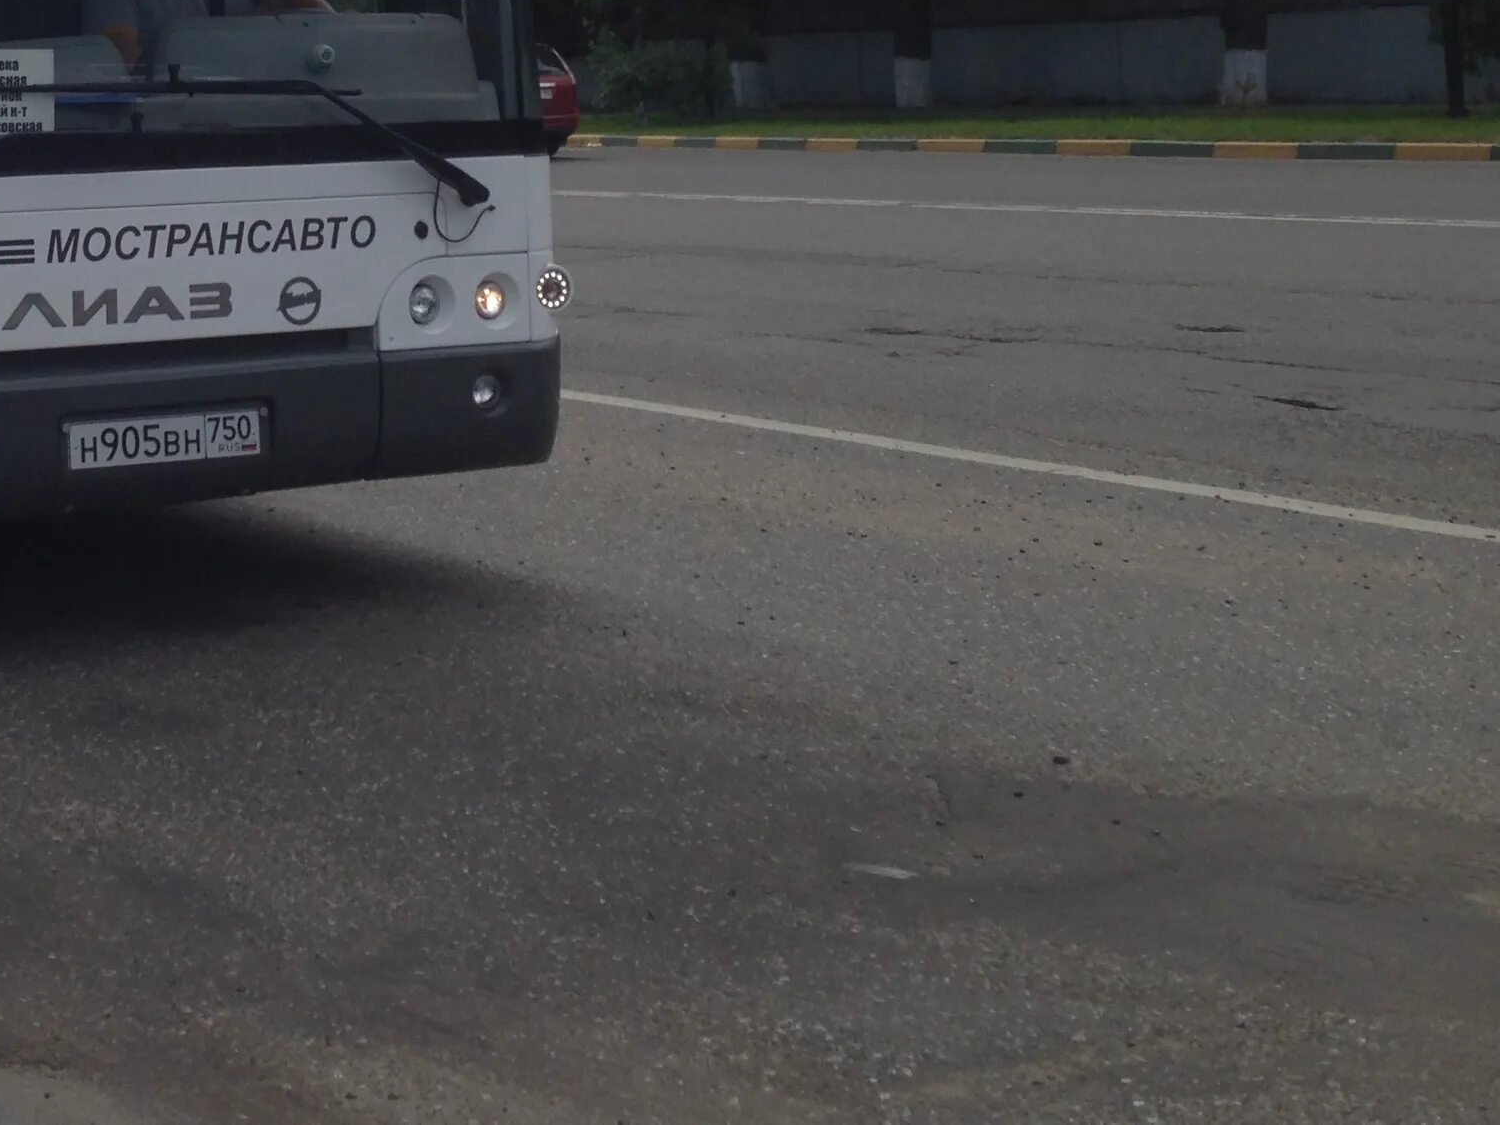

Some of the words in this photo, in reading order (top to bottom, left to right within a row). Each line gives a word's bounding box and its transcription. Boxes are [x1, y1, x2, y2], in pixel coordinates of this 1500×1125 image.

[47, 215, 377, 264] МОСТРАНСАВТО
[1, 282, 233, 331] ЛИАЗ
[80, 424, 201, 463] Н905ВН
[207, 415, 252, 443] 750
[218, 442, 241, 453] RUS
